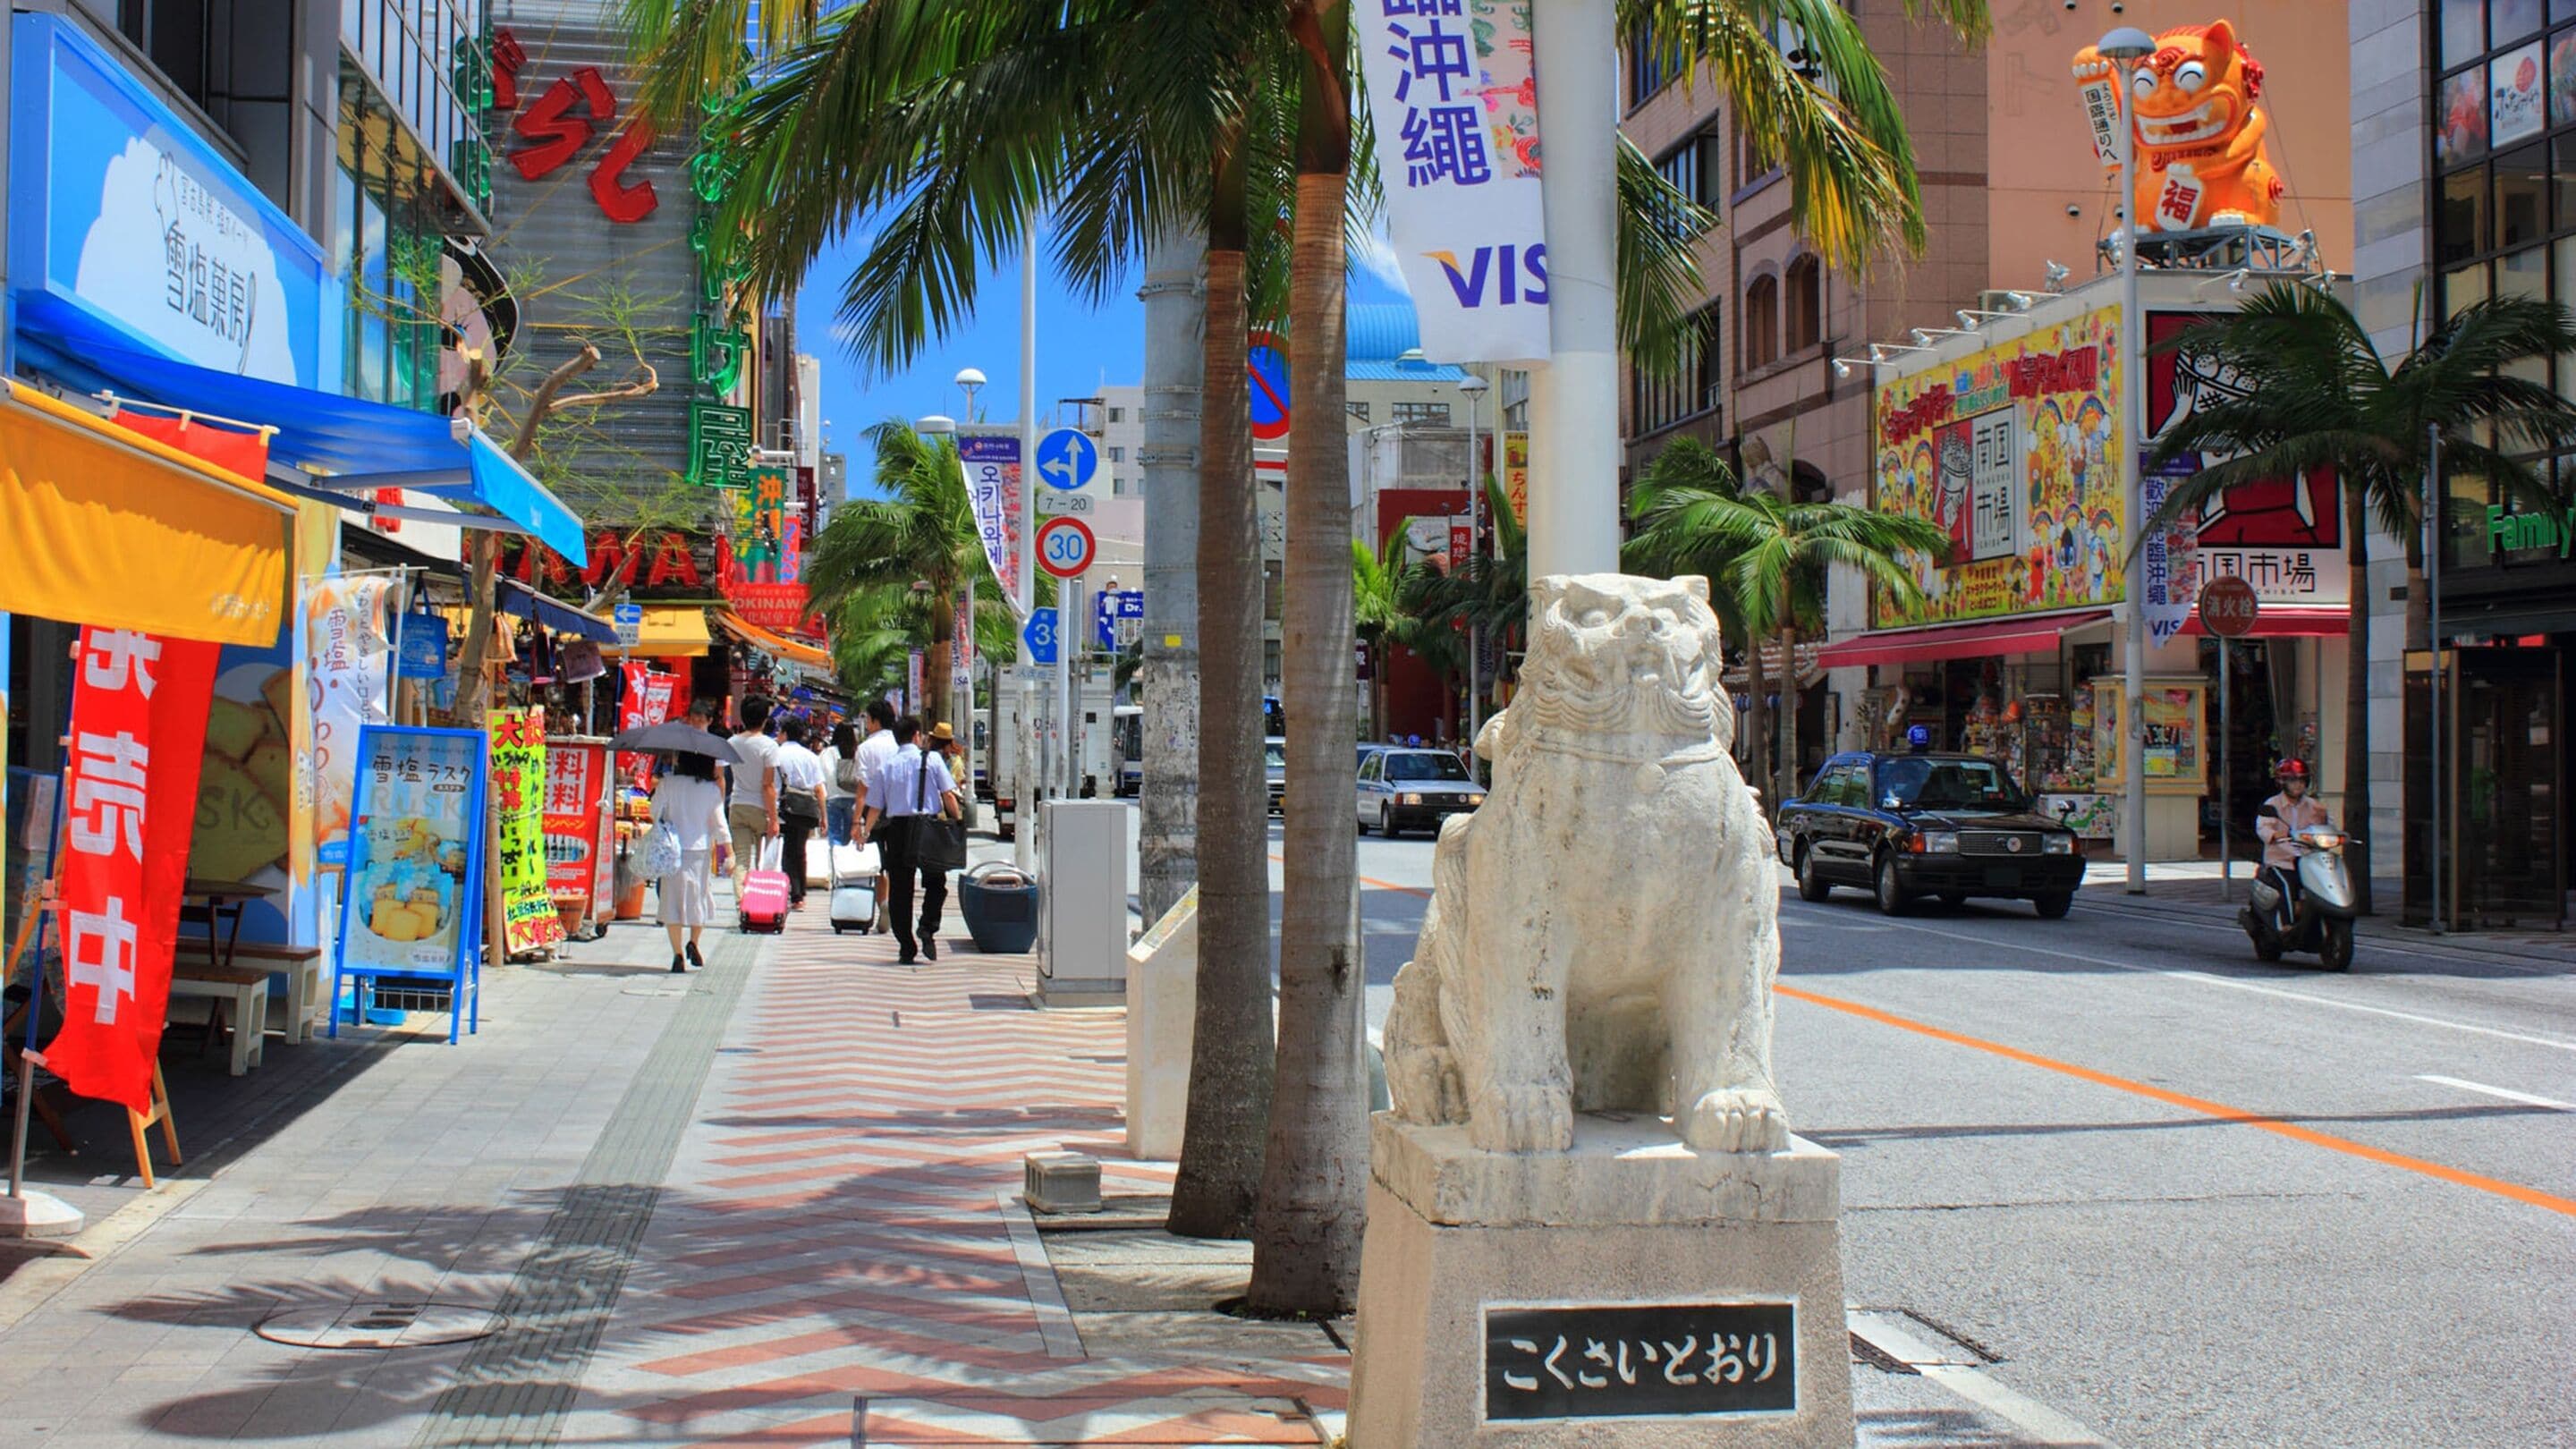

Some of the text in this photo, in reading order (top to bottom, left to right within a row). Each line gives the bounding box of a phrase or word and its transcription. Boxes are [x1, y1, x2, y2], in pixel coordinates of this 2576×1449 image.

[2161, 179, 2199, 223] 福
[166, 221, 245, 348] 雪塩菓房
[1049, 533, 1083, 562] 30
[2207, 596, 2253, 617] 消火栓
[325, 608, 350, 674] 雪塩
[371, 754, 471, 784] 雪塩ラスク
[1504, 1332, 1776, 1392] こくさいとおり
